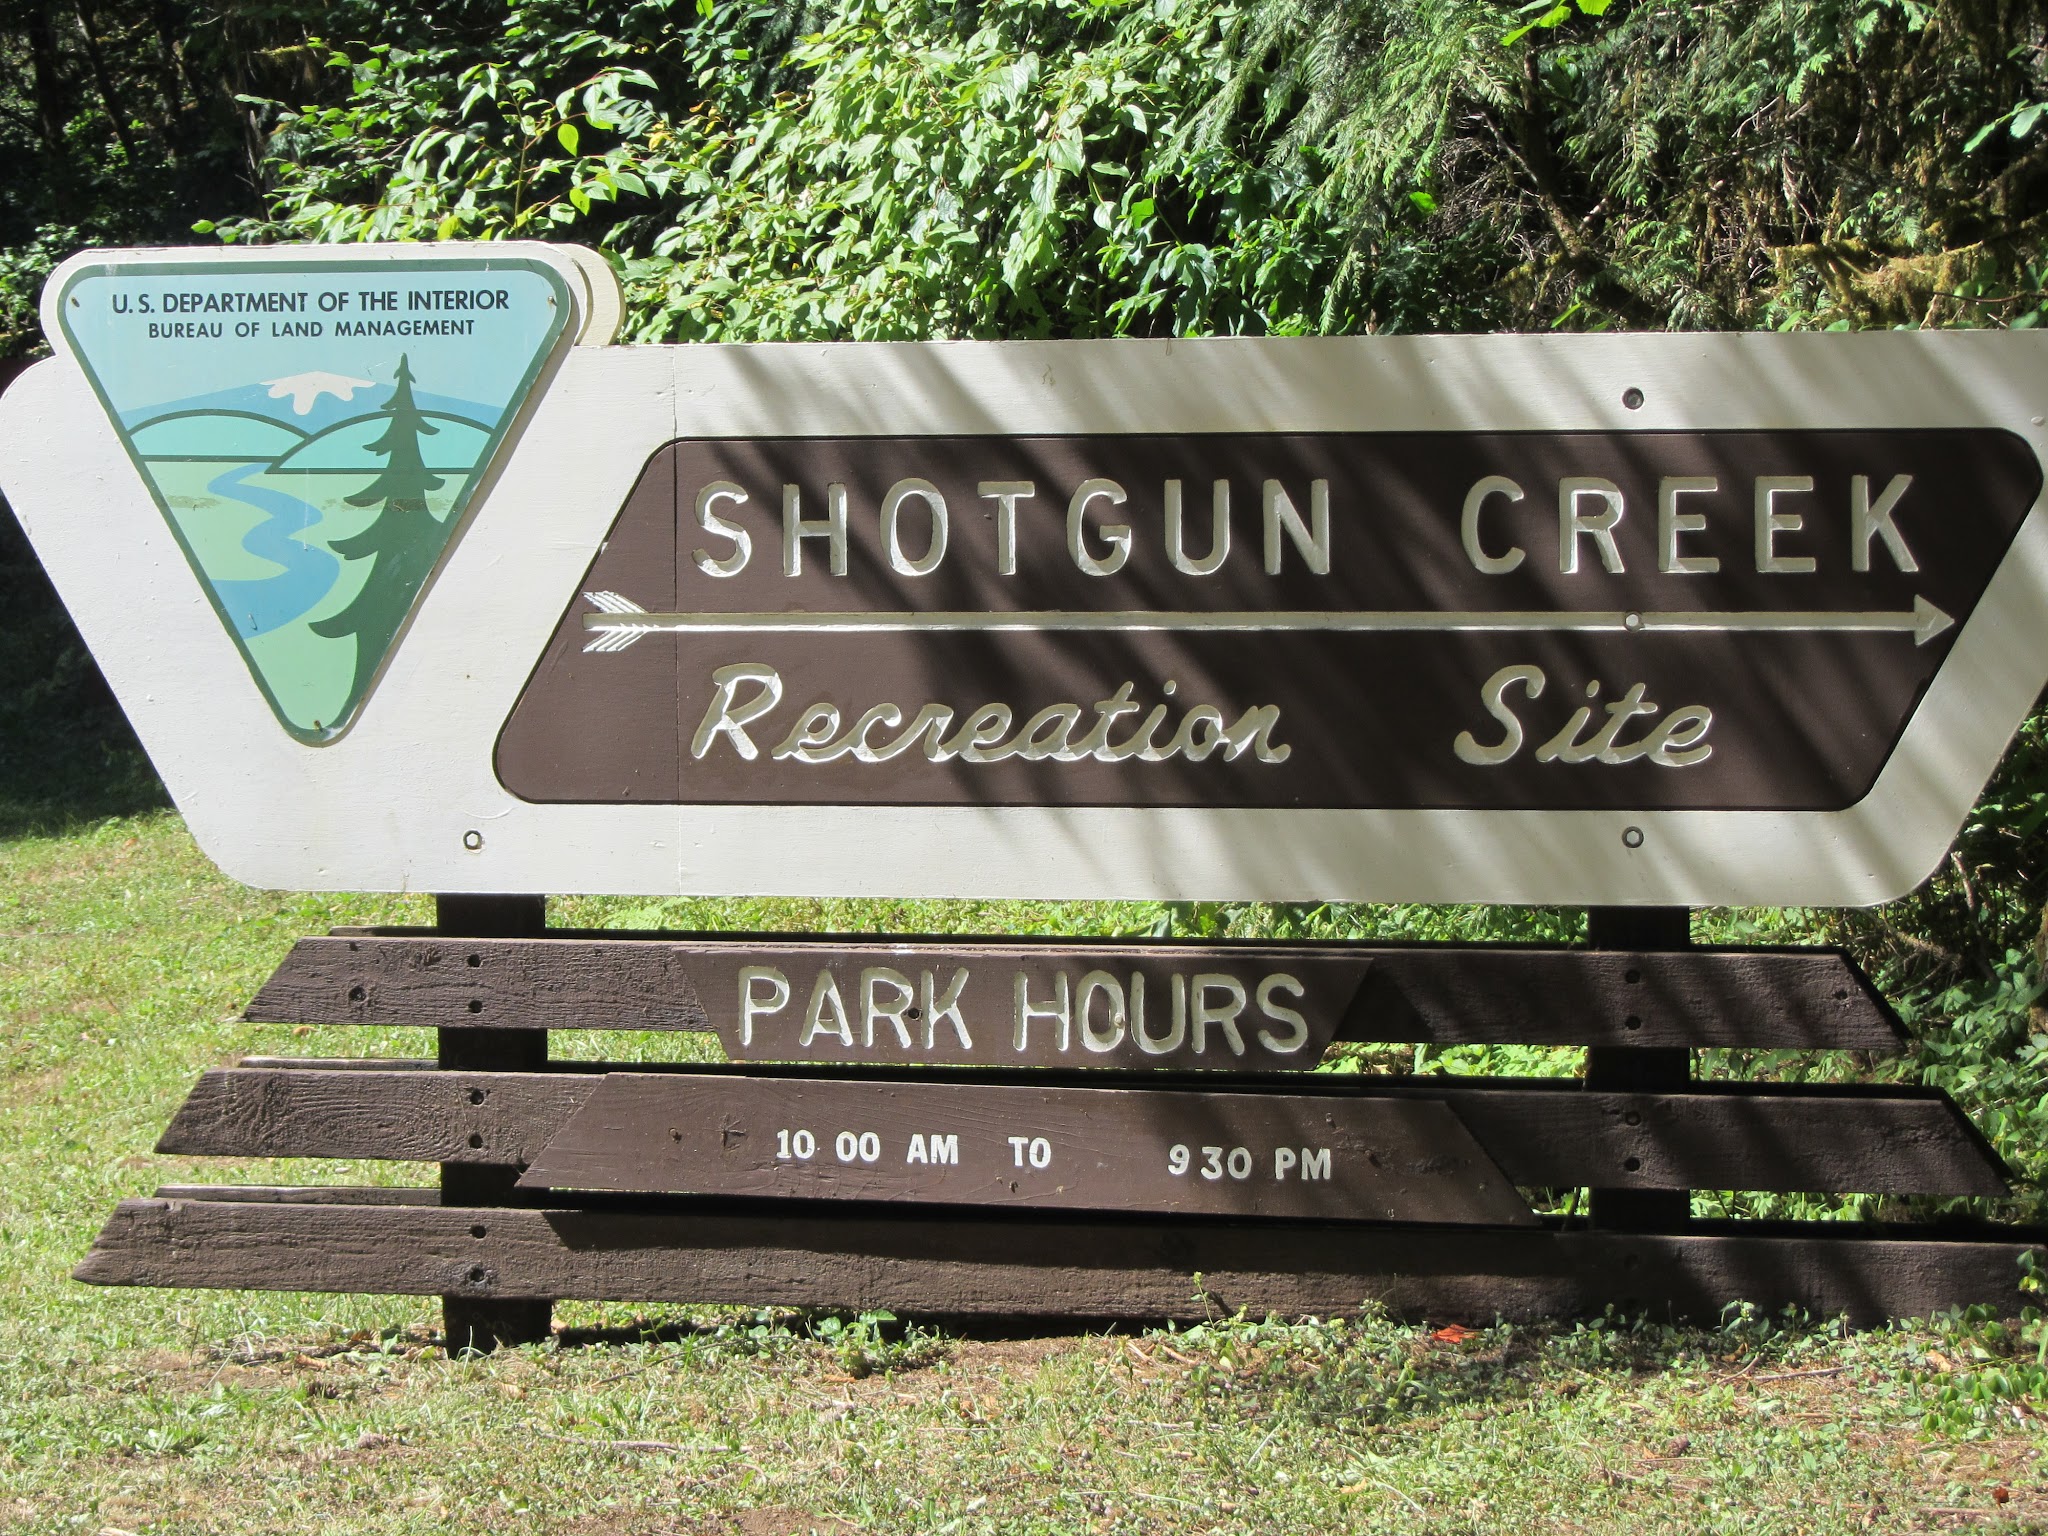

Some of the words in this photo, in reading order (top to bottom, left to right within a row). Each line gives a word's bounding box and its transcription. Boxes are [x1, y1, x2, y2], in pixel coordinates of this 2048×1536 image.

[149, 322, 223, 338] BUREAU
[235, 322, 260, 337] OF
[272, 321, 323, 337] LAND
[335, 319, 475, 337] MANAGEMENT
[163, 292, 308, 313] DEPARTMENT
[318, 291, 349, 312] OF
[358, 291, 398, 311] THE
[408, 289, 509, 311] INTERIOR
[692, 478, 1330, 577] SHOTGUN
[1460, 475, 1919, 574] CREEK
[690, 662, 1292, 763] Recreation
[1453, 664, 1713, 767] Site
[738, 966, 973, 1050] PARK
[1013, 969, 1308, 1056] HOURS
[906, 1133, 958, 1164] AM
[1008, 1136, 1052, 1168] TO
[1274, 1147, 1332, 1180] PM
